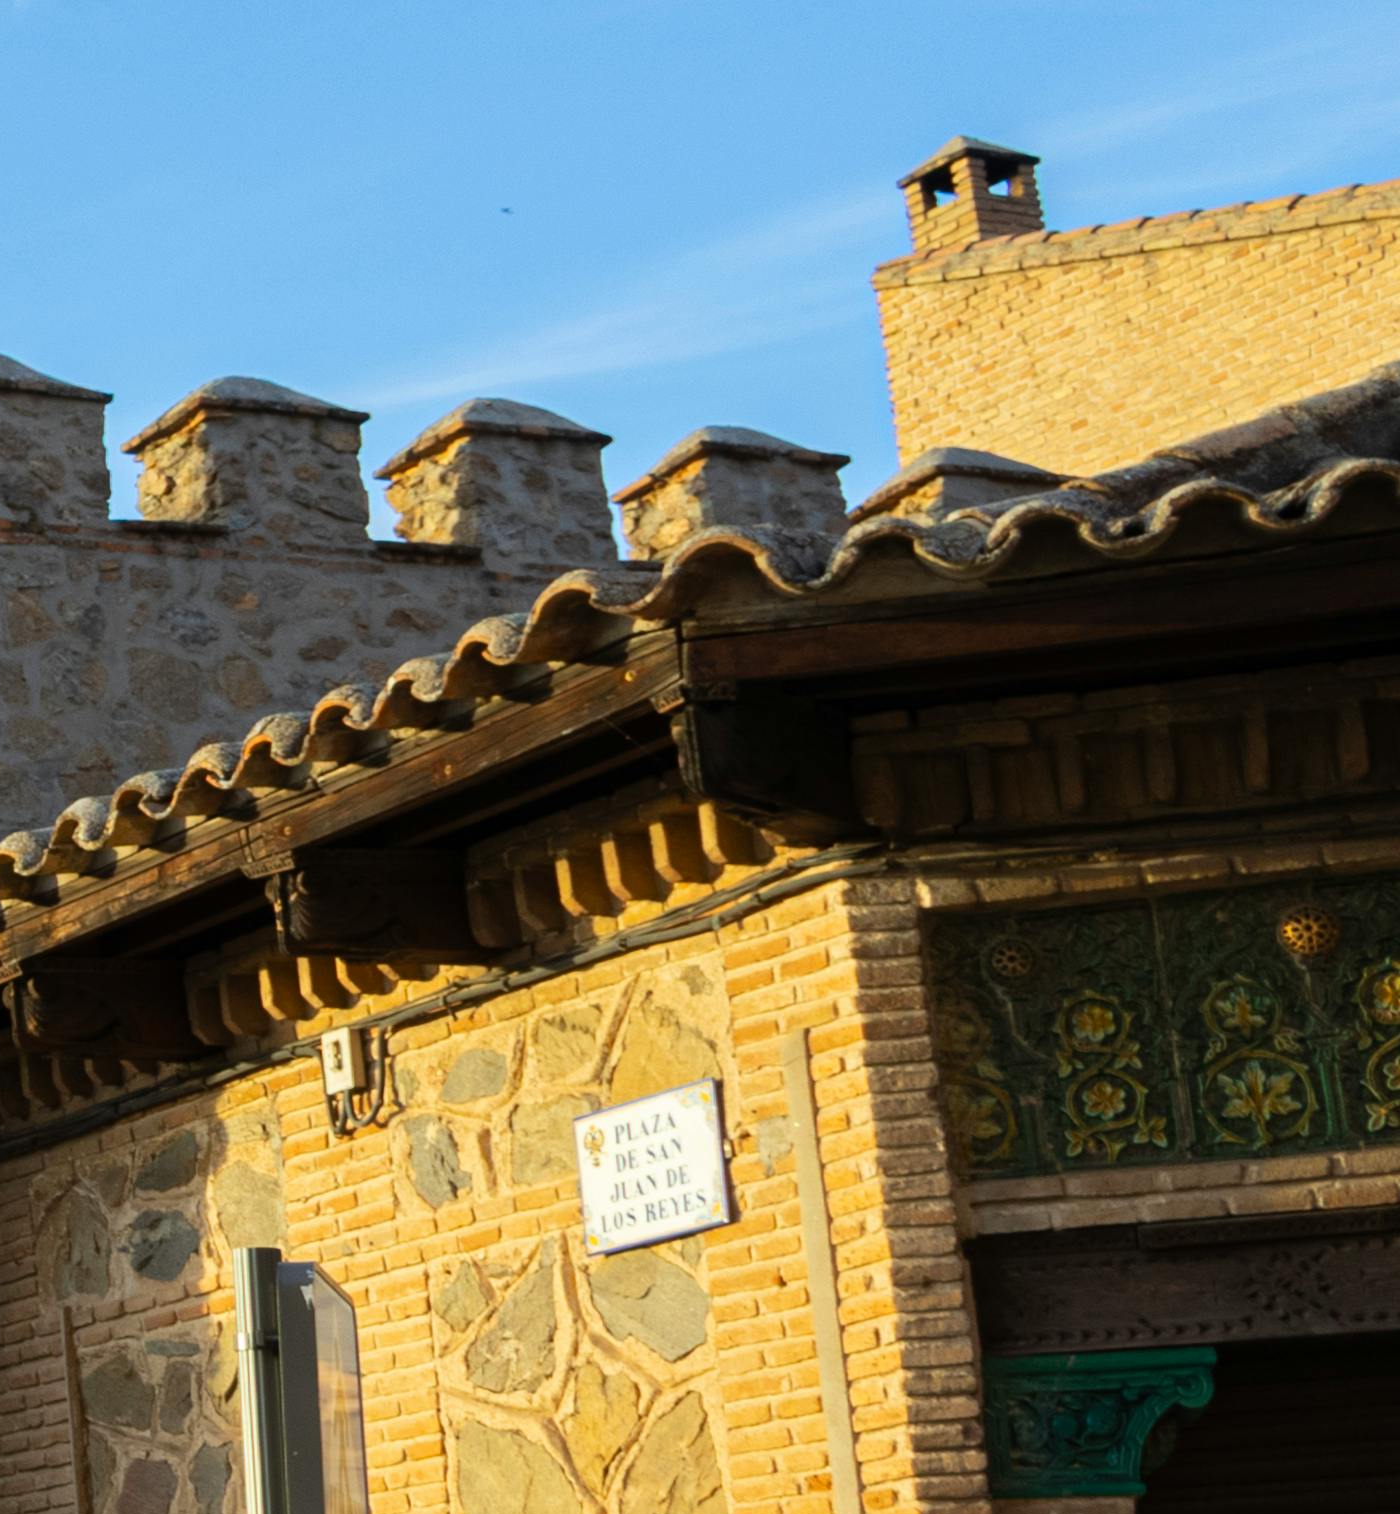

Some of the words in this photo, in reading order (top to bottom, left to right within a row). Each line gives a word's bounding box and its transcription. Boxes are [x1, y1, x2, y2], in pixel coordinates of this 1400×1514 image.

[614, 1112, 676, 1144] PLAZA
[616, 1149, 639, 1172] DE
[647, 1138, 682, 1164] SAN
[610, 1175, 658, 1202] JUAN
[666, 1165, 690, 1188] DE
[602, 1207, 637, 1233] LOS
[645, 1189, 706, 1223] REYES
